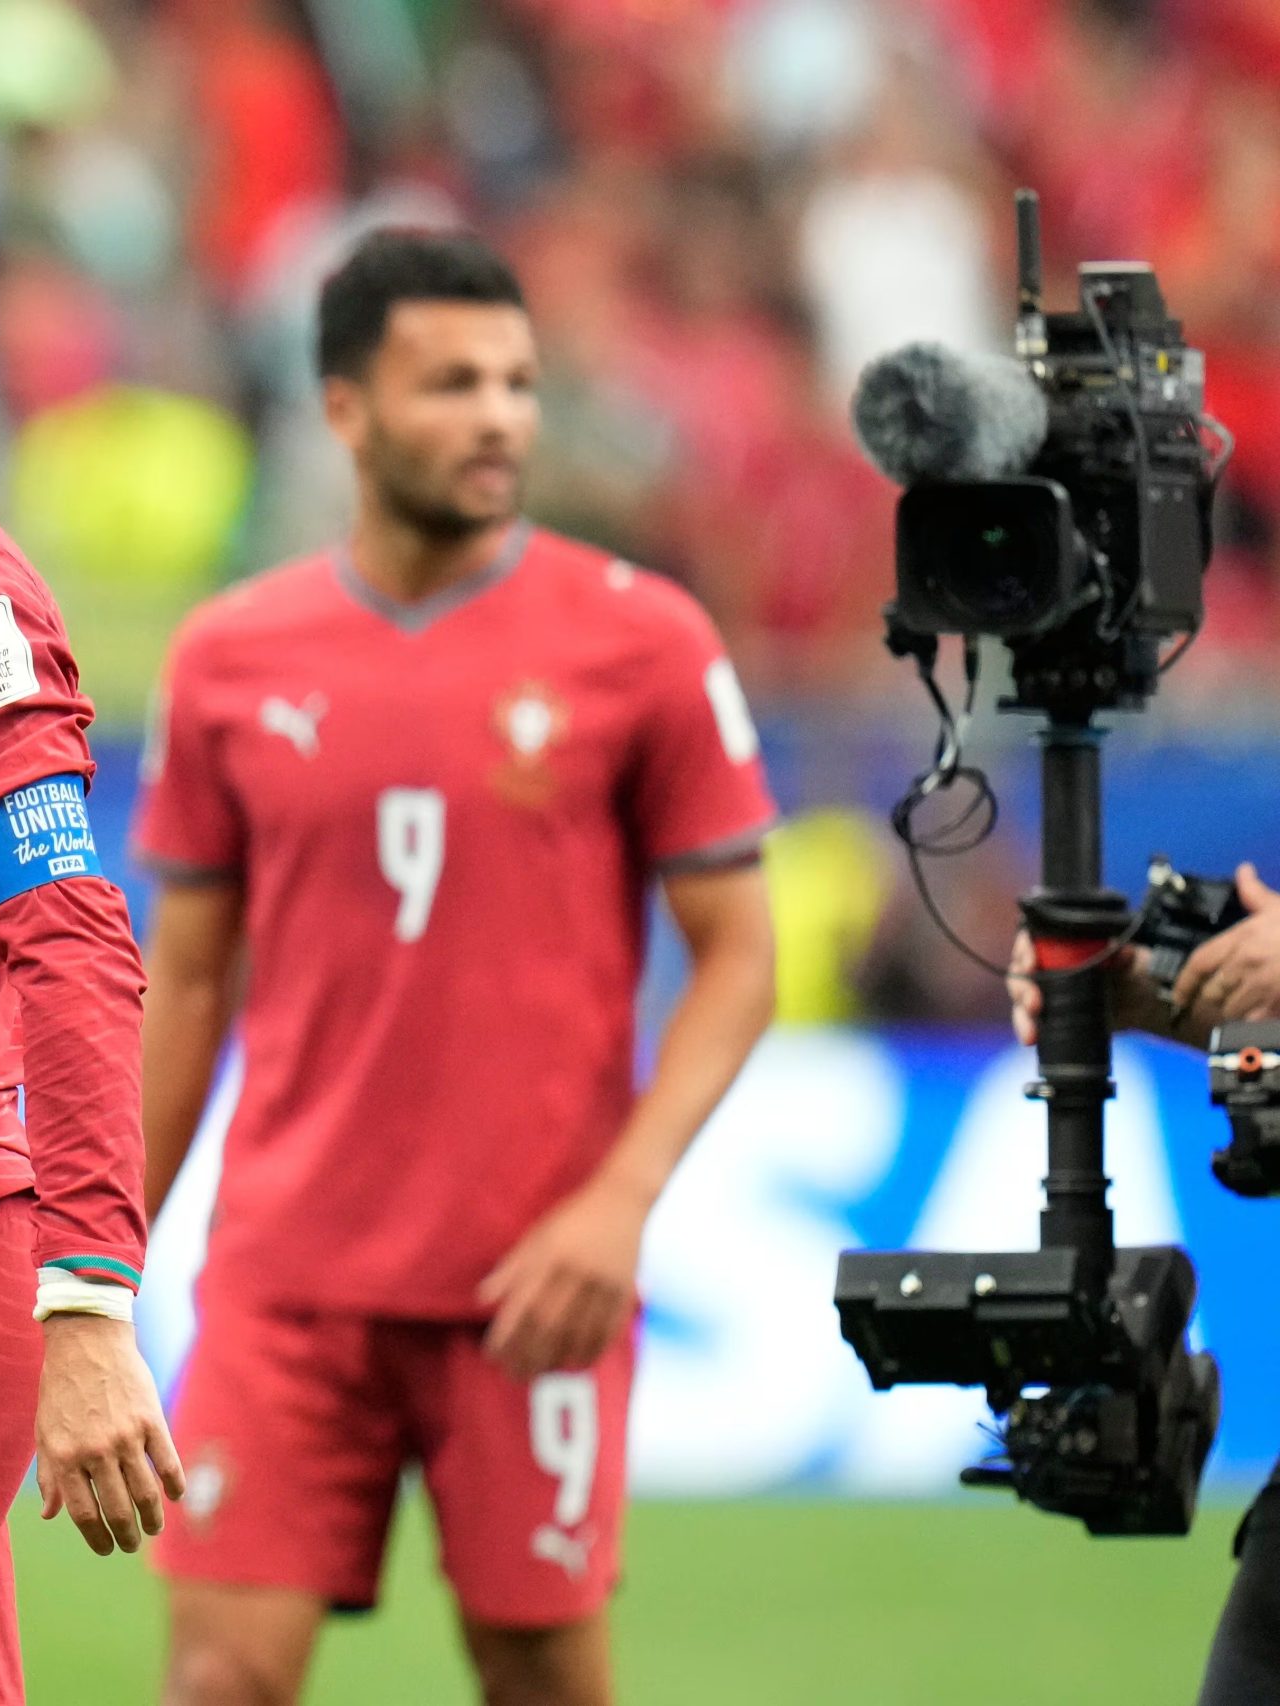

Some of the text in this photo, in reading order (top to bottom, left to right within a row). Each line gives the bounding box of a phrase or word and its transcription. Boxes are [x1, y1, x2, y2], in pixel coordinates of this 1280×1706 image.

[3, 783, 82, 814] FOOTBALL
[9, 802, 88, 839] UNITES
[13, 829, 96, 865] the World
[52, 858, 83, 872] FIFA
[376, 785, 446, 943] 9
[529, 1371, 600, 1527] 9
